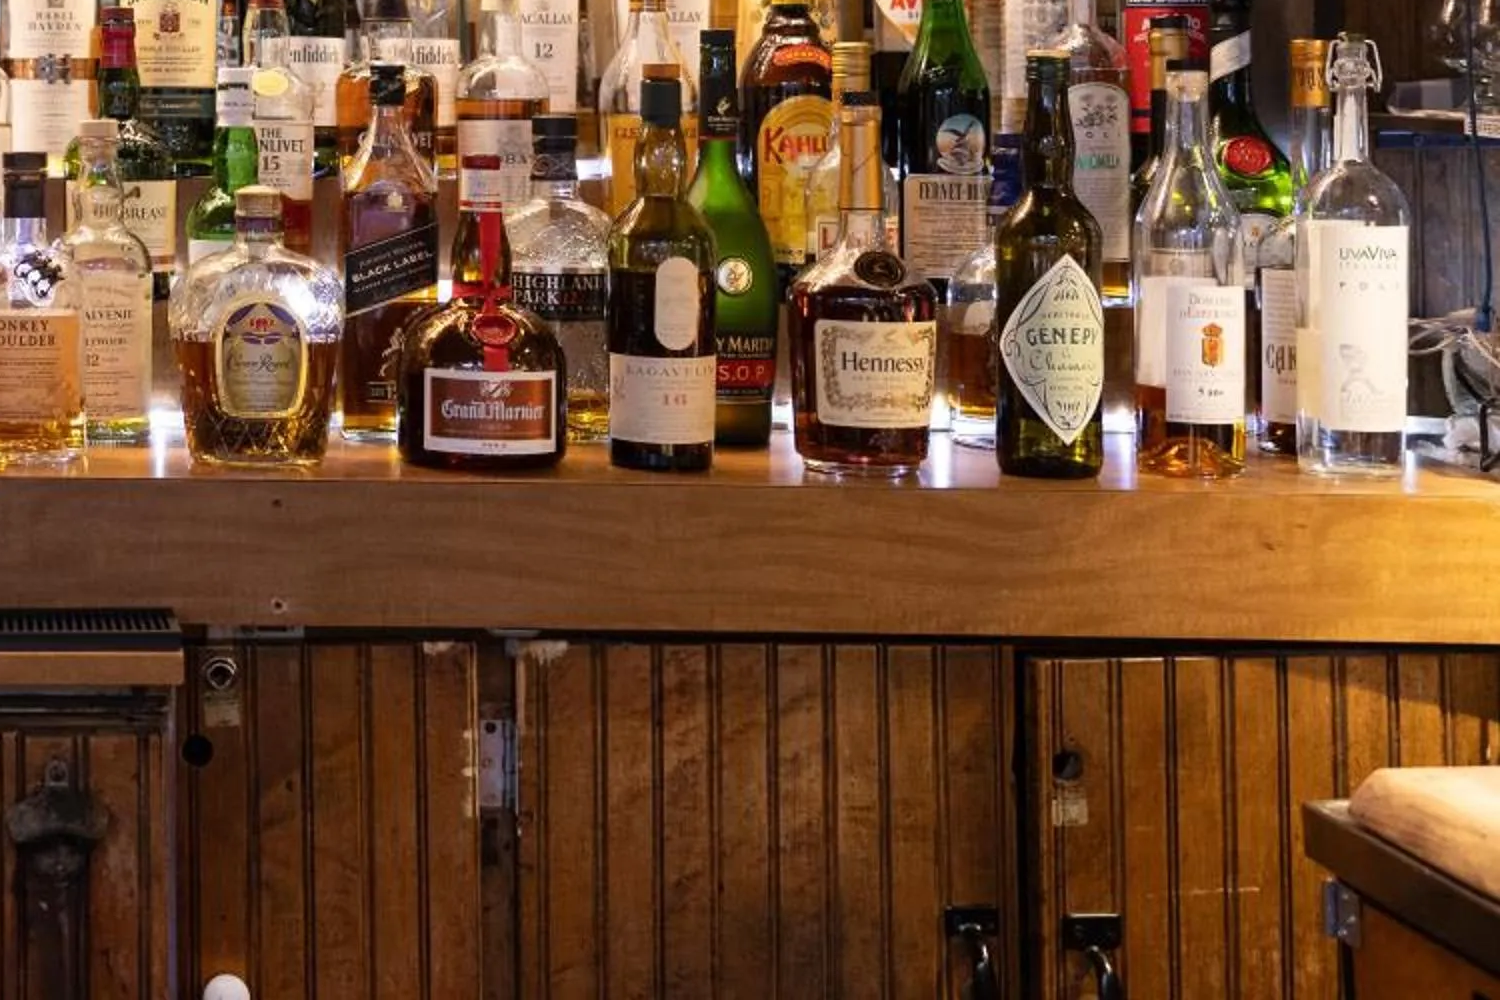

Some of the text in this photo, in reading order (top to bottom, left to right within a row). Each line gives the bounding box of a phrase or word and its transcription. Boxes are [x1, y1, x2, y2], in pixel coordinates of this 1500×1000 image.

[520, 13, 574, 26] ACALLAN
[535, 42, 554, 58] 12
[260, 127, 283, 139] THE
[259, 139, 304, 153] NLIVET
[262, 155, 280, 171] 15
[352, 250, 433, 284] BLACK LABEL
[513, 289, 560, 305] PARK
[85, 309, 132, 321] ALVENIE
